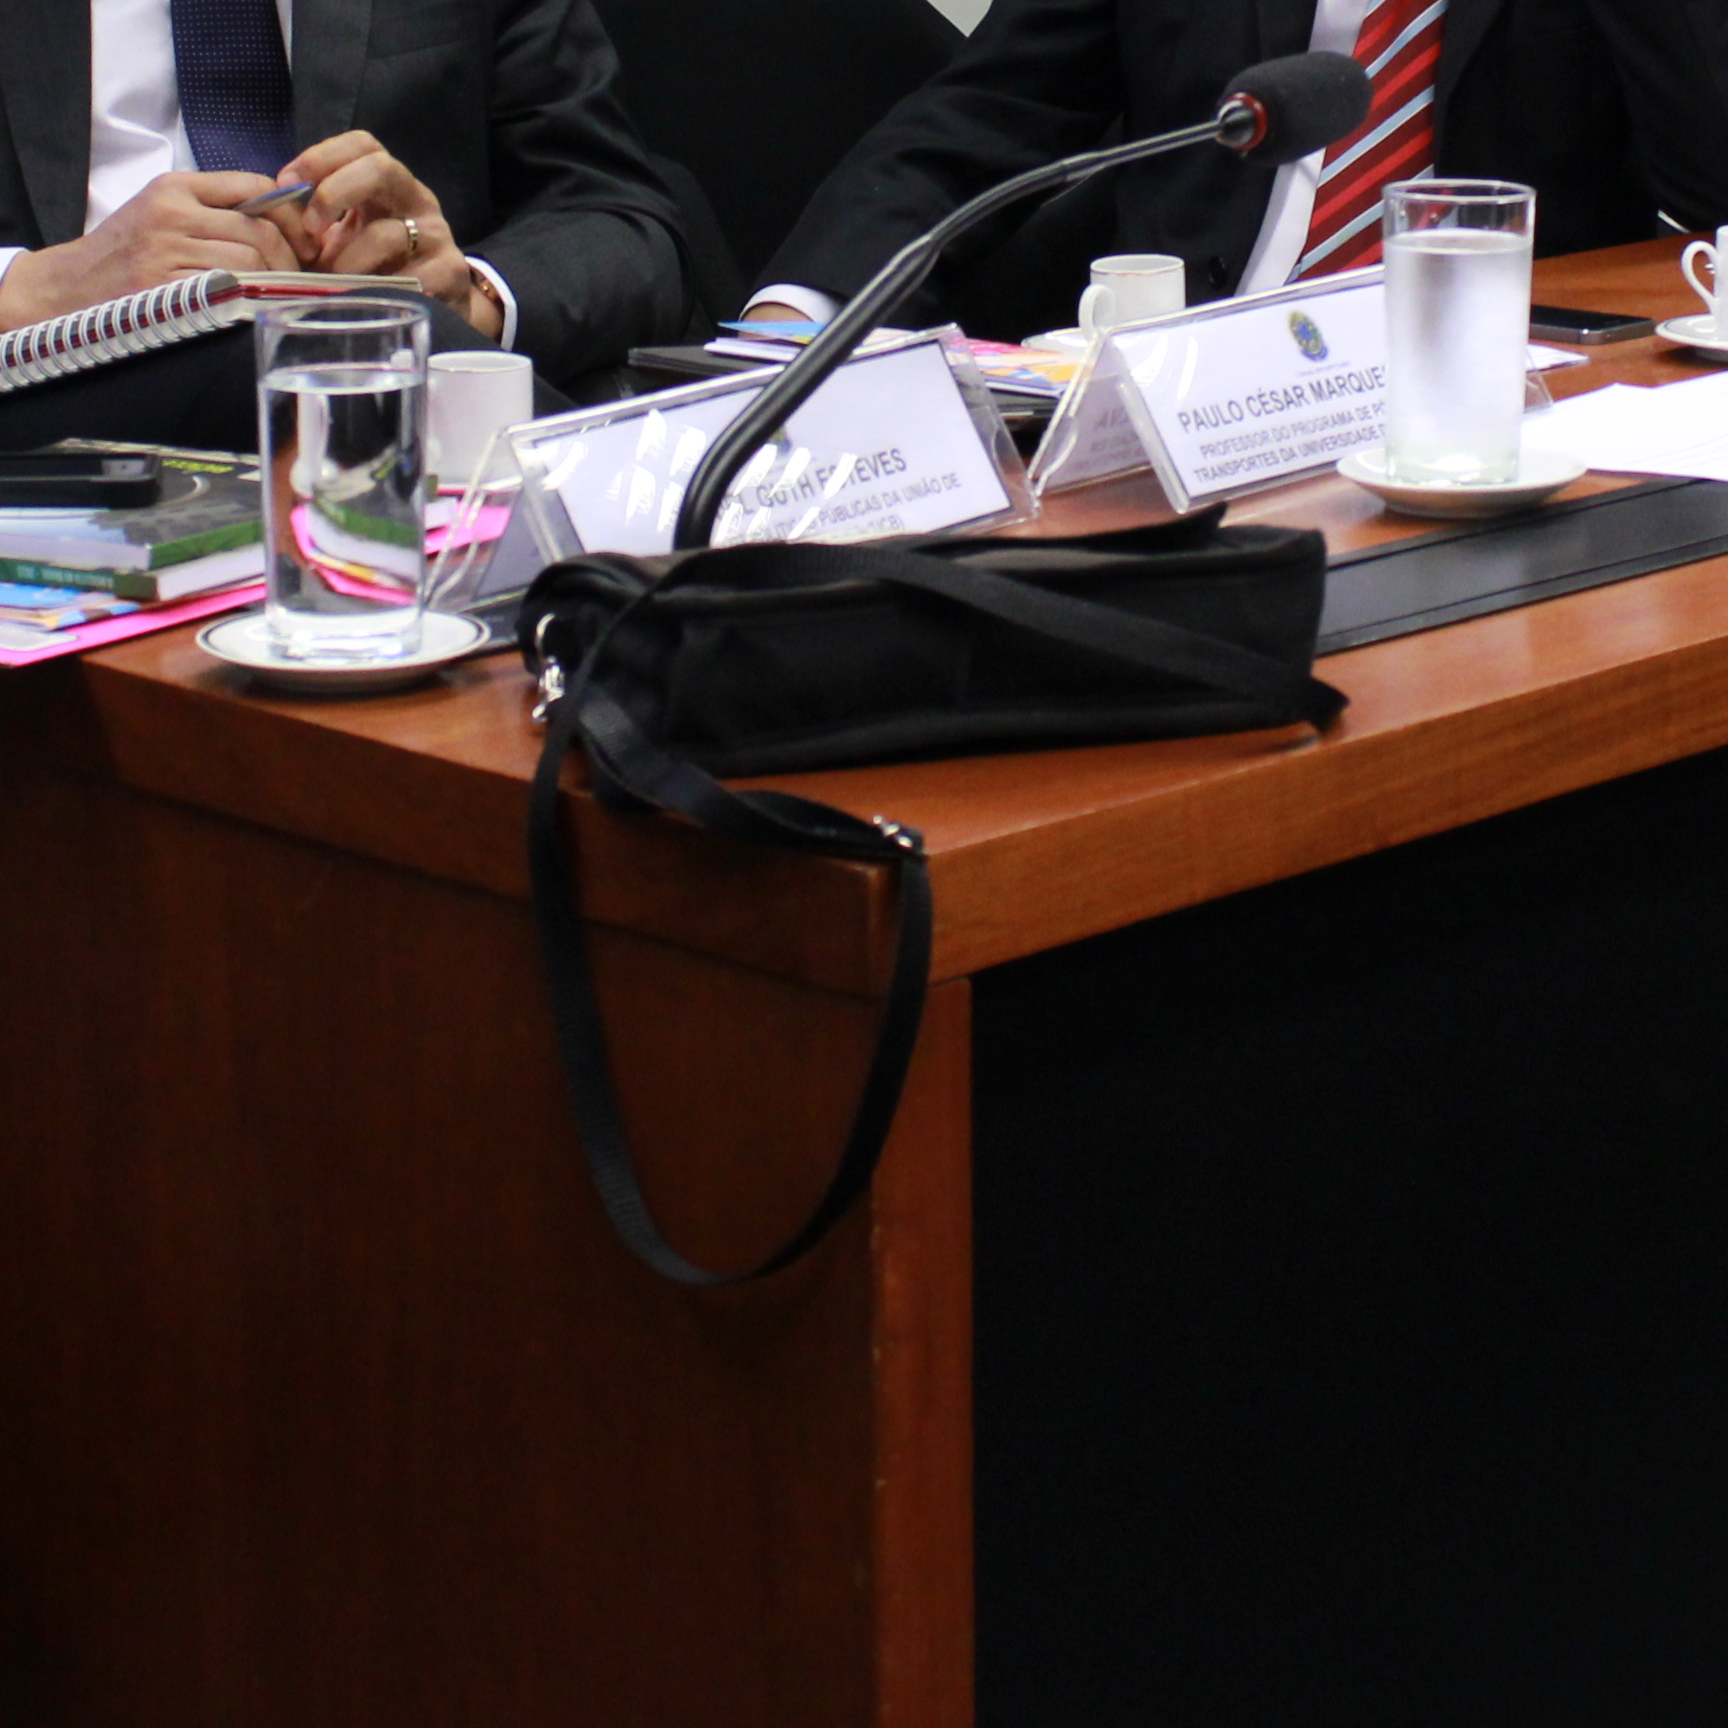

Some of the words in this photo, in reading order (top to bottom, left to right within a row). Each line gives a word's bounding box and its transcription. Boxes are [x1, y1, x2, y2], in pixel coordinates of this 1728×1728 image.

[1177, 400, 1245, 434] PAULO
[1245, 385, 1310, 418] CÉSAR
[1308, 365, 1386, 403] MARQUE
[1194, 449, 1280, 483] TRANSPORTES
[1279, 445, 1297, 462] DA
[1296, 425, 1379, 458] UNIVERSIDADE
[1200, 429, 1271, 459] PROFESSOR
[1271, 424, 1291, 442] DO
[1290, 410, 1355, 437] PROGRAMA
